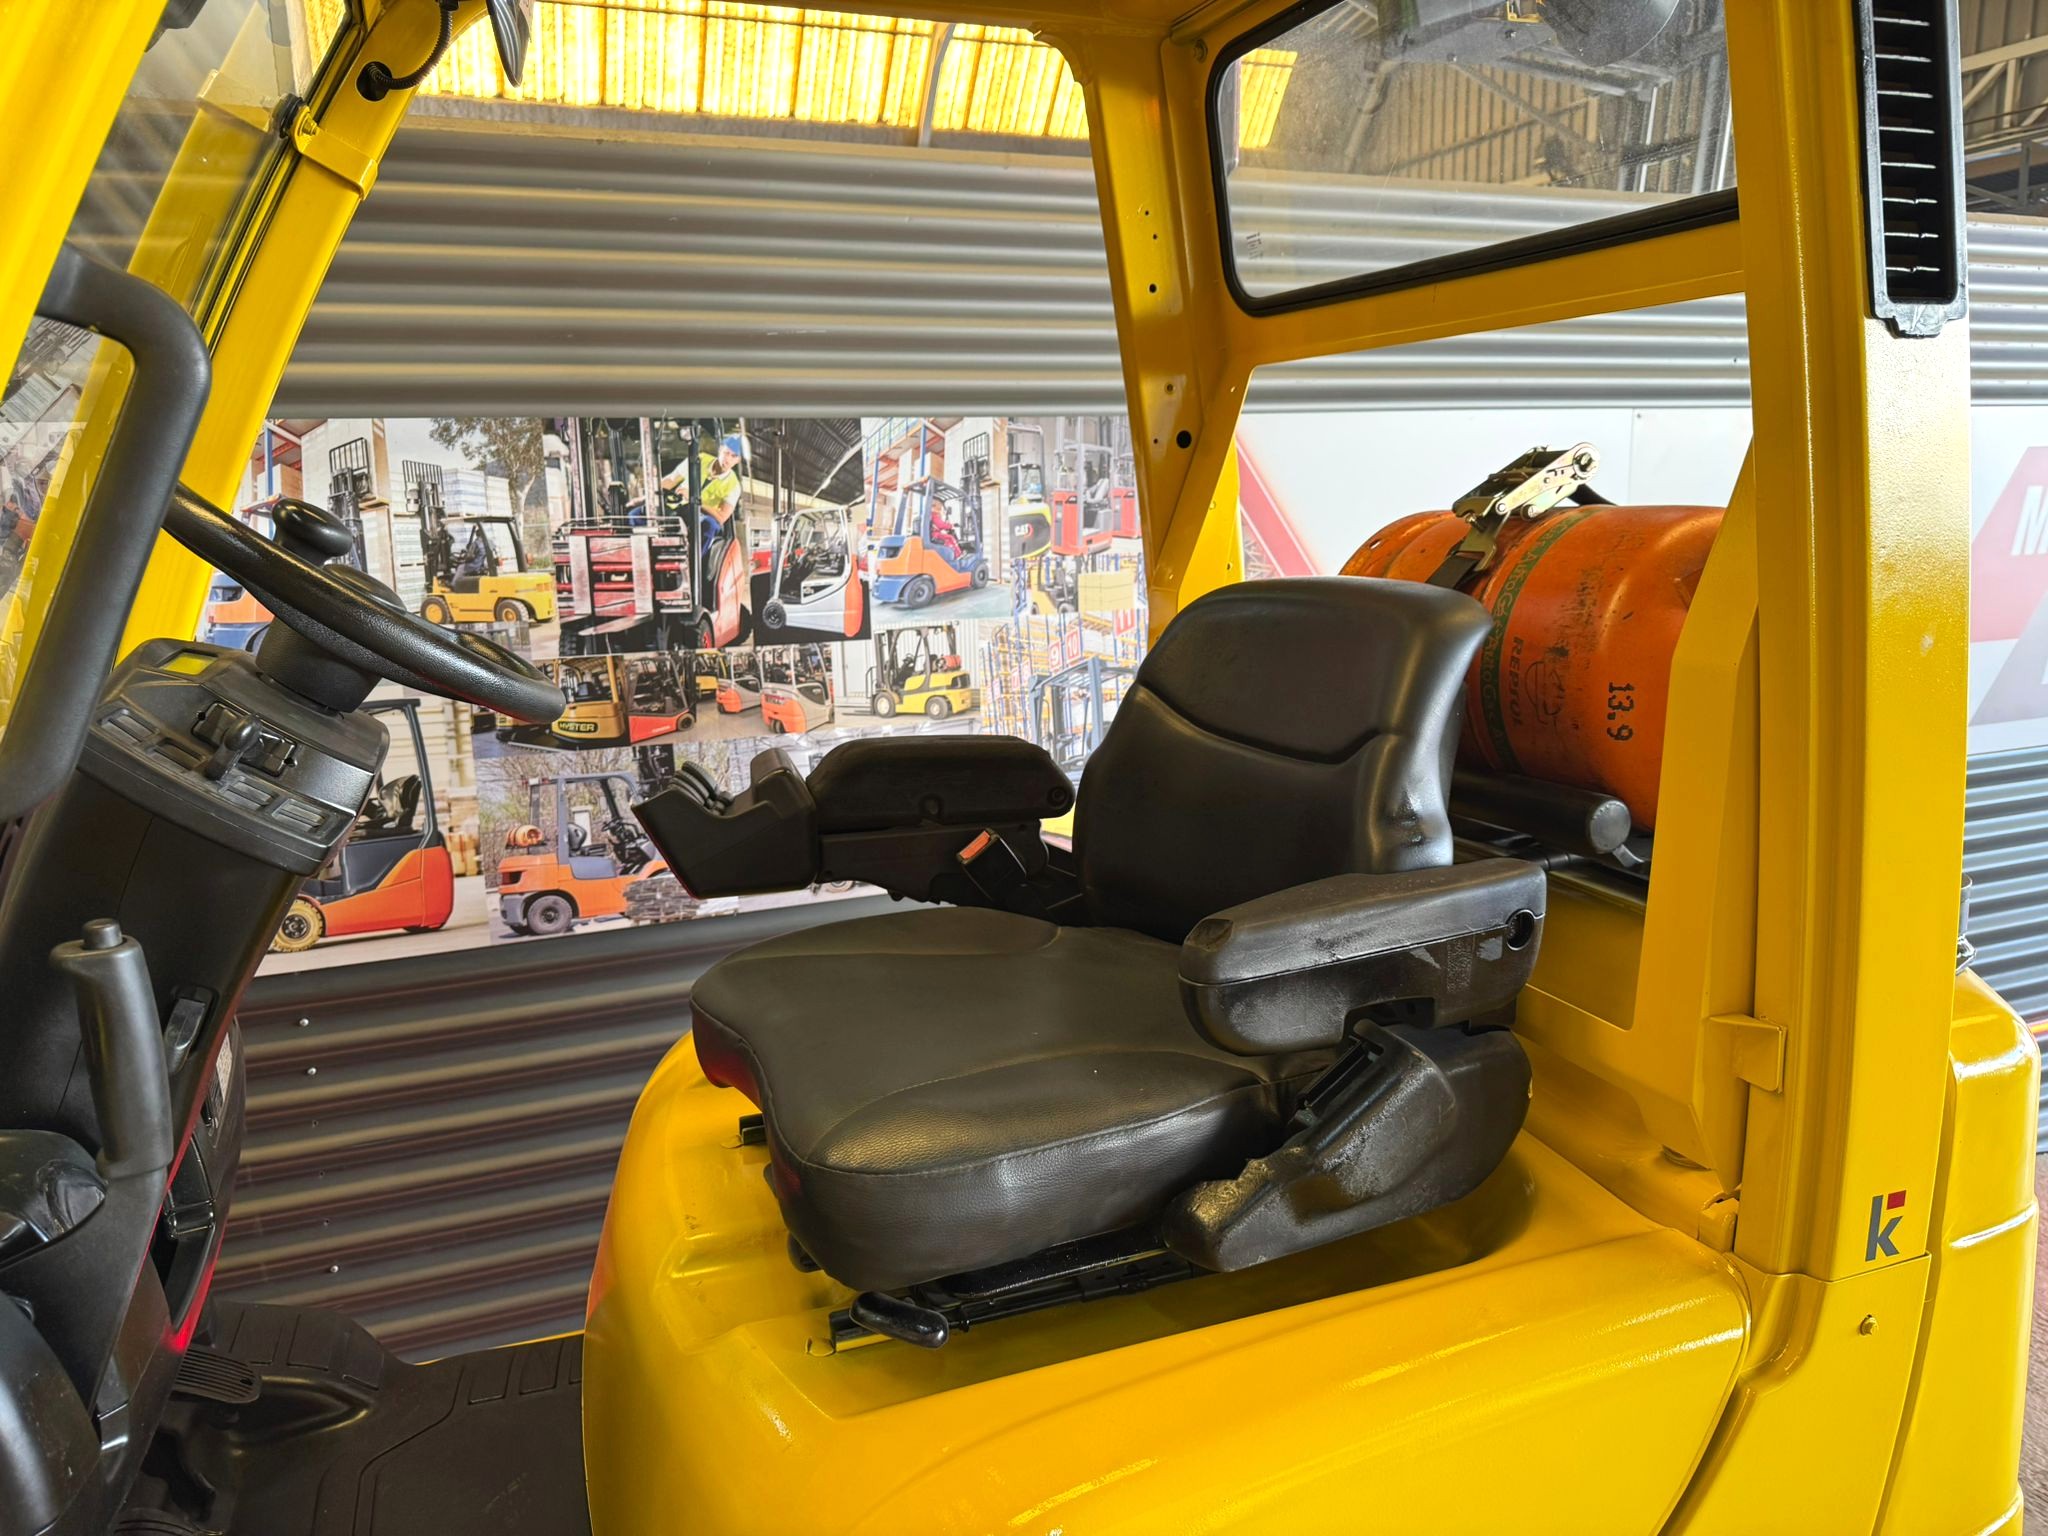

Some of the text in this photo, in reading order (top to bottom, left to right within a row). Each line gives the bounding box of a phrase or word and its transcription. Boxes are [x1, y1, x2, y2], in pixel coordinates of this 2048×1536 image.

[1067, 632, 1079, 657] 10
[1510, 636, 1524, 726] REPSOL
[560, 722, 595, 732] HYSTER
[1606, 681, 1634, 741] 13.9
